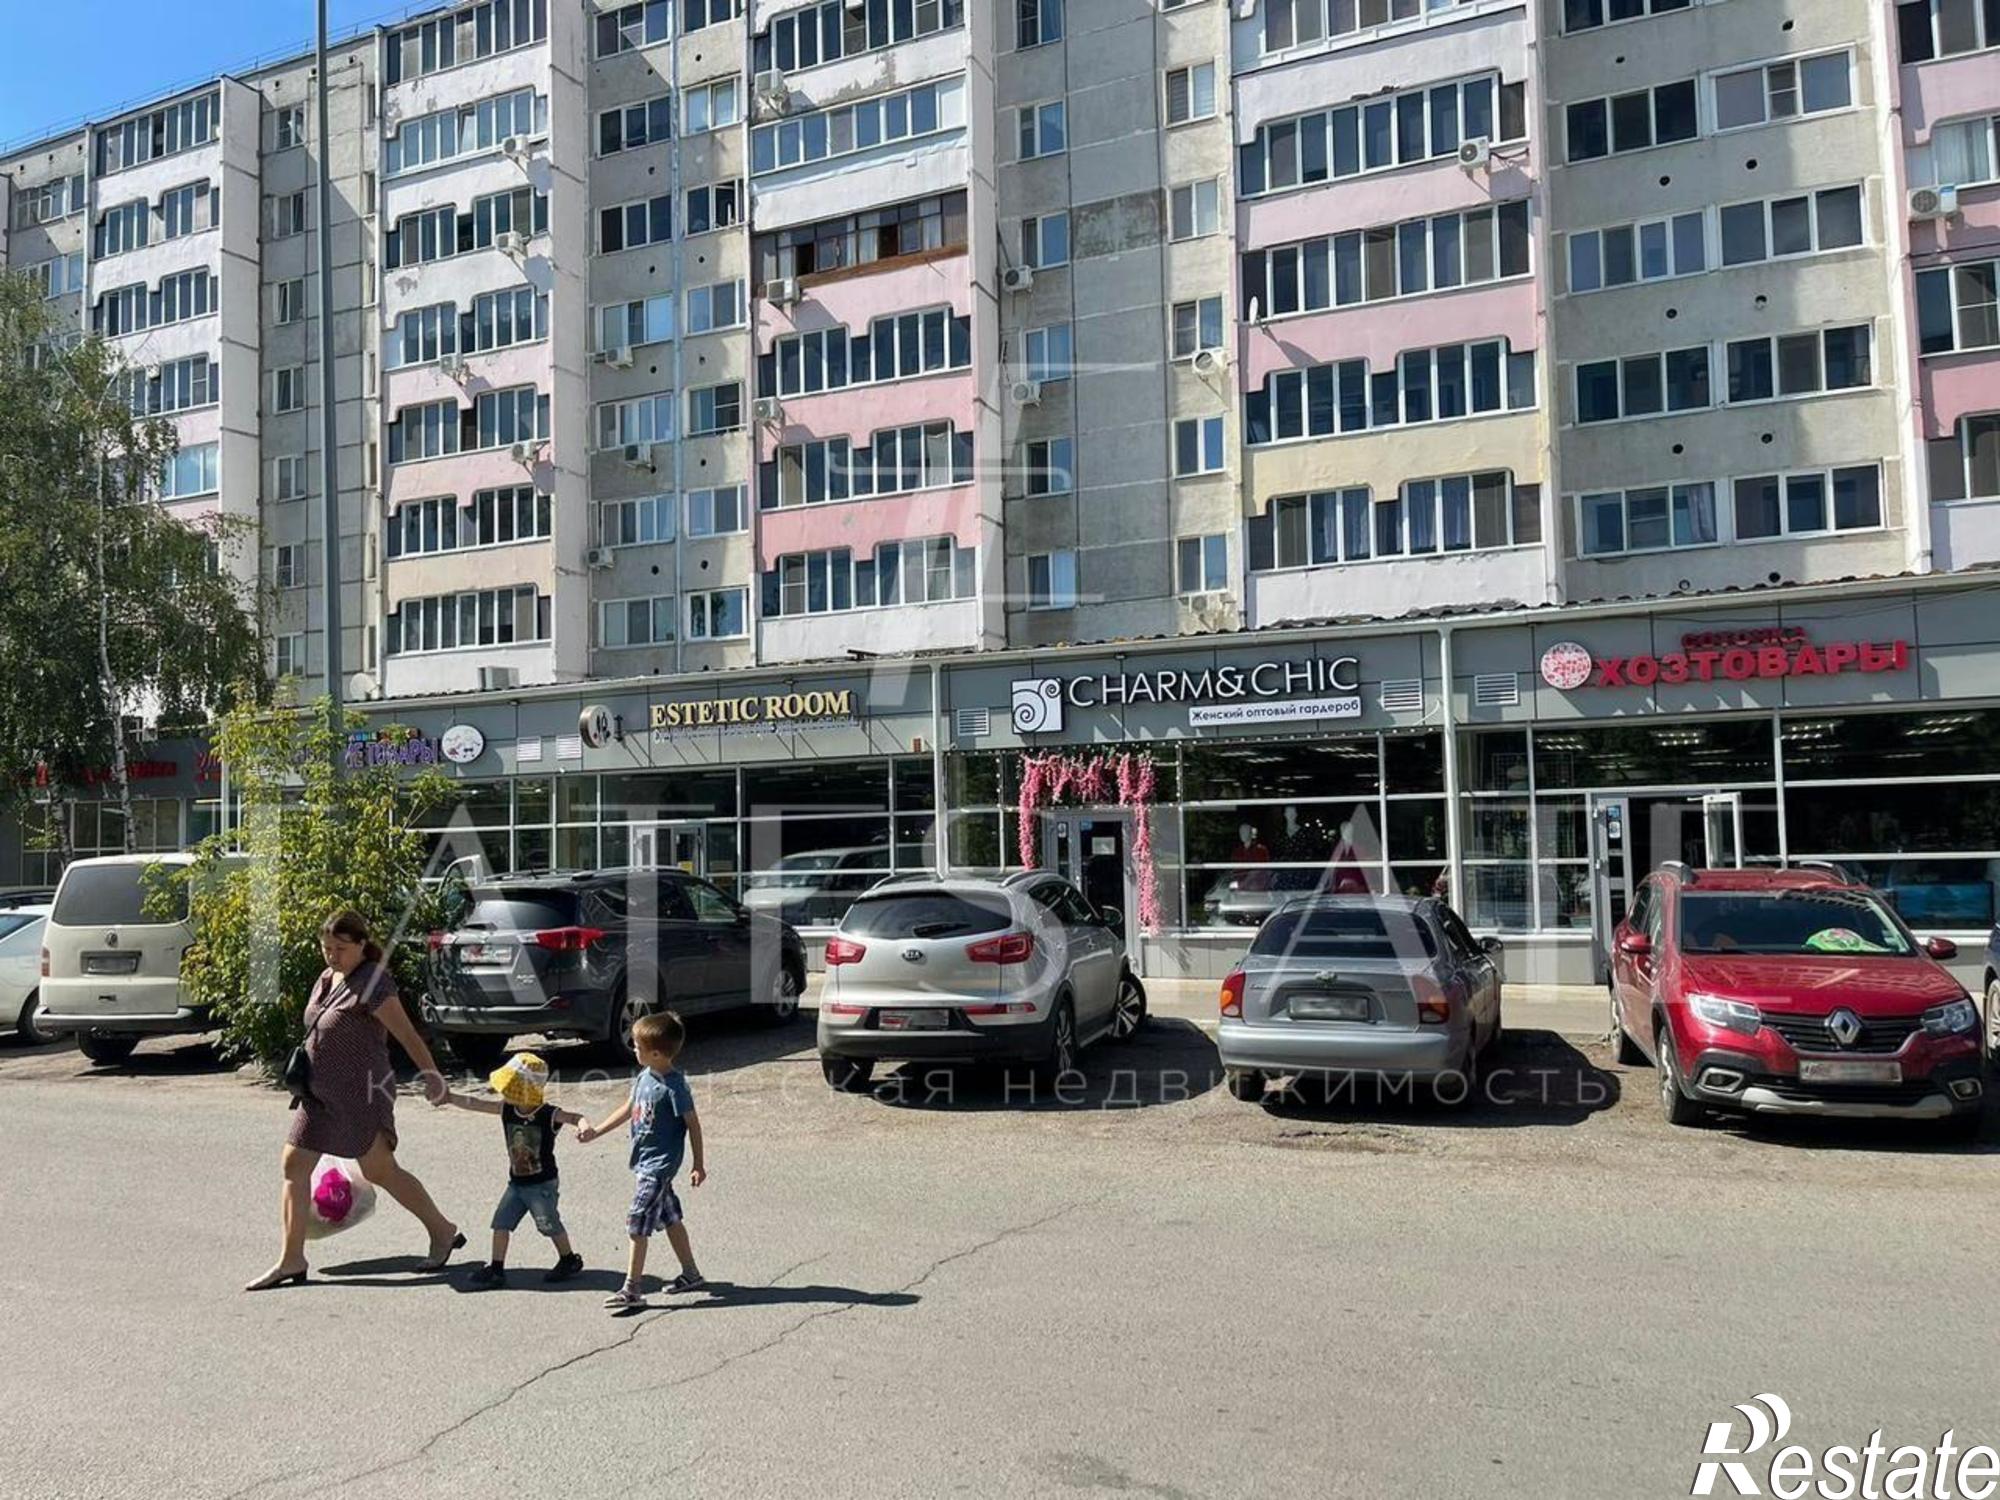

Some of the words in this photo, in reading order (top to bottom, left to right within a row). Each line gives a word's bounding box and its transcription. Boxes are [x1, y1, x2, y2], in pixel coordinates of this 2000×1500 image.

[1068, 656, 1361, 708] CHARM&CHIC
[1597, 640, 1909, 688] ХОЗТОВАРЫ
[649, 695, 761, 729] ESTETIC
[764, 689, 852, 721] ROOM
[1191, 706, 1244, 722] Женский
[1246, 703, 1297, 719] оптовый
[1299, 700, 1360, 716] гардероб
